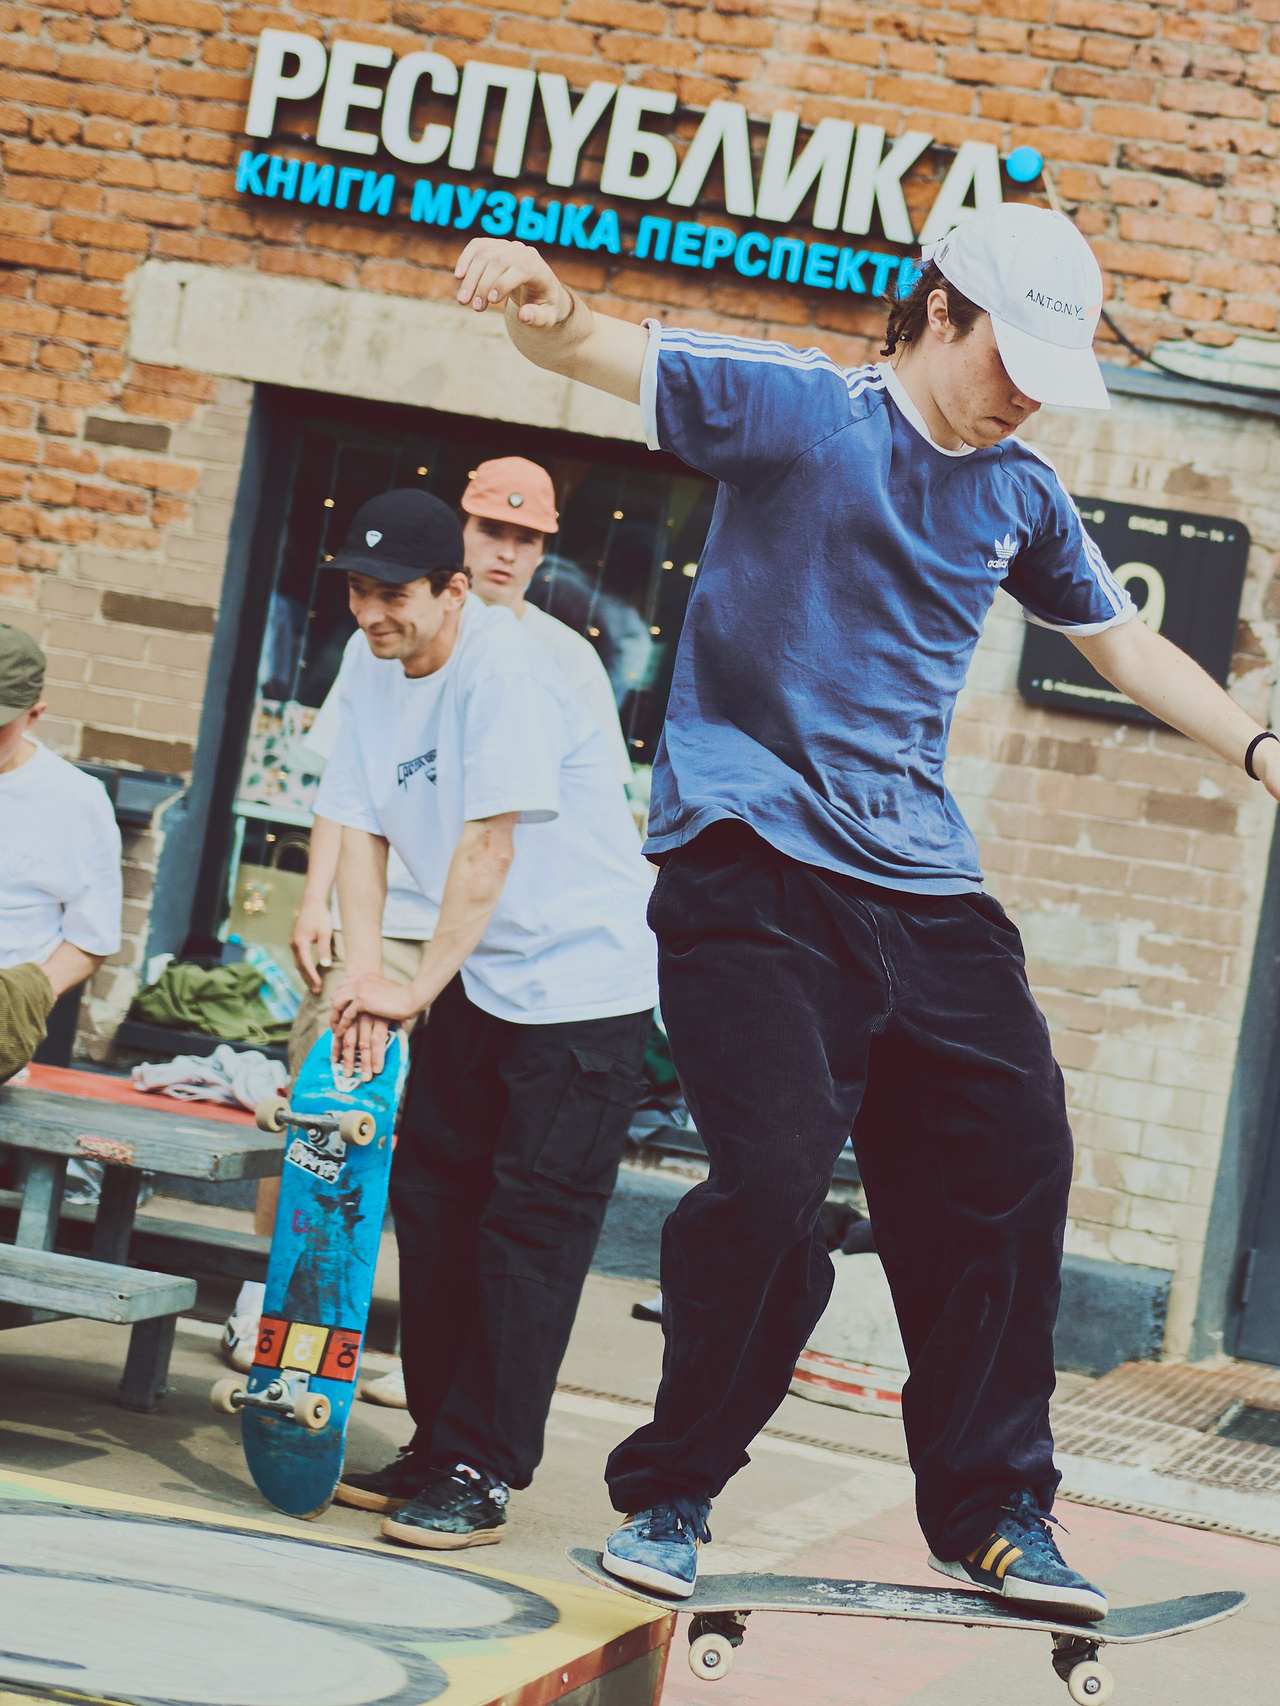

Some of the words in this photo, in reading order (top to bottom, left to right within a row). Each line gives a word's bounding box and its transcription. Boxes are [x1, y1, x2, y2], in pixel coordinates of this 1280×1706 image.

[236, 150, 396, 216] КНИГИ
[411, 178, 620, 254] МУЗЫКА
[245, 28, 1003, 246] РЕСПУБЛИКА
